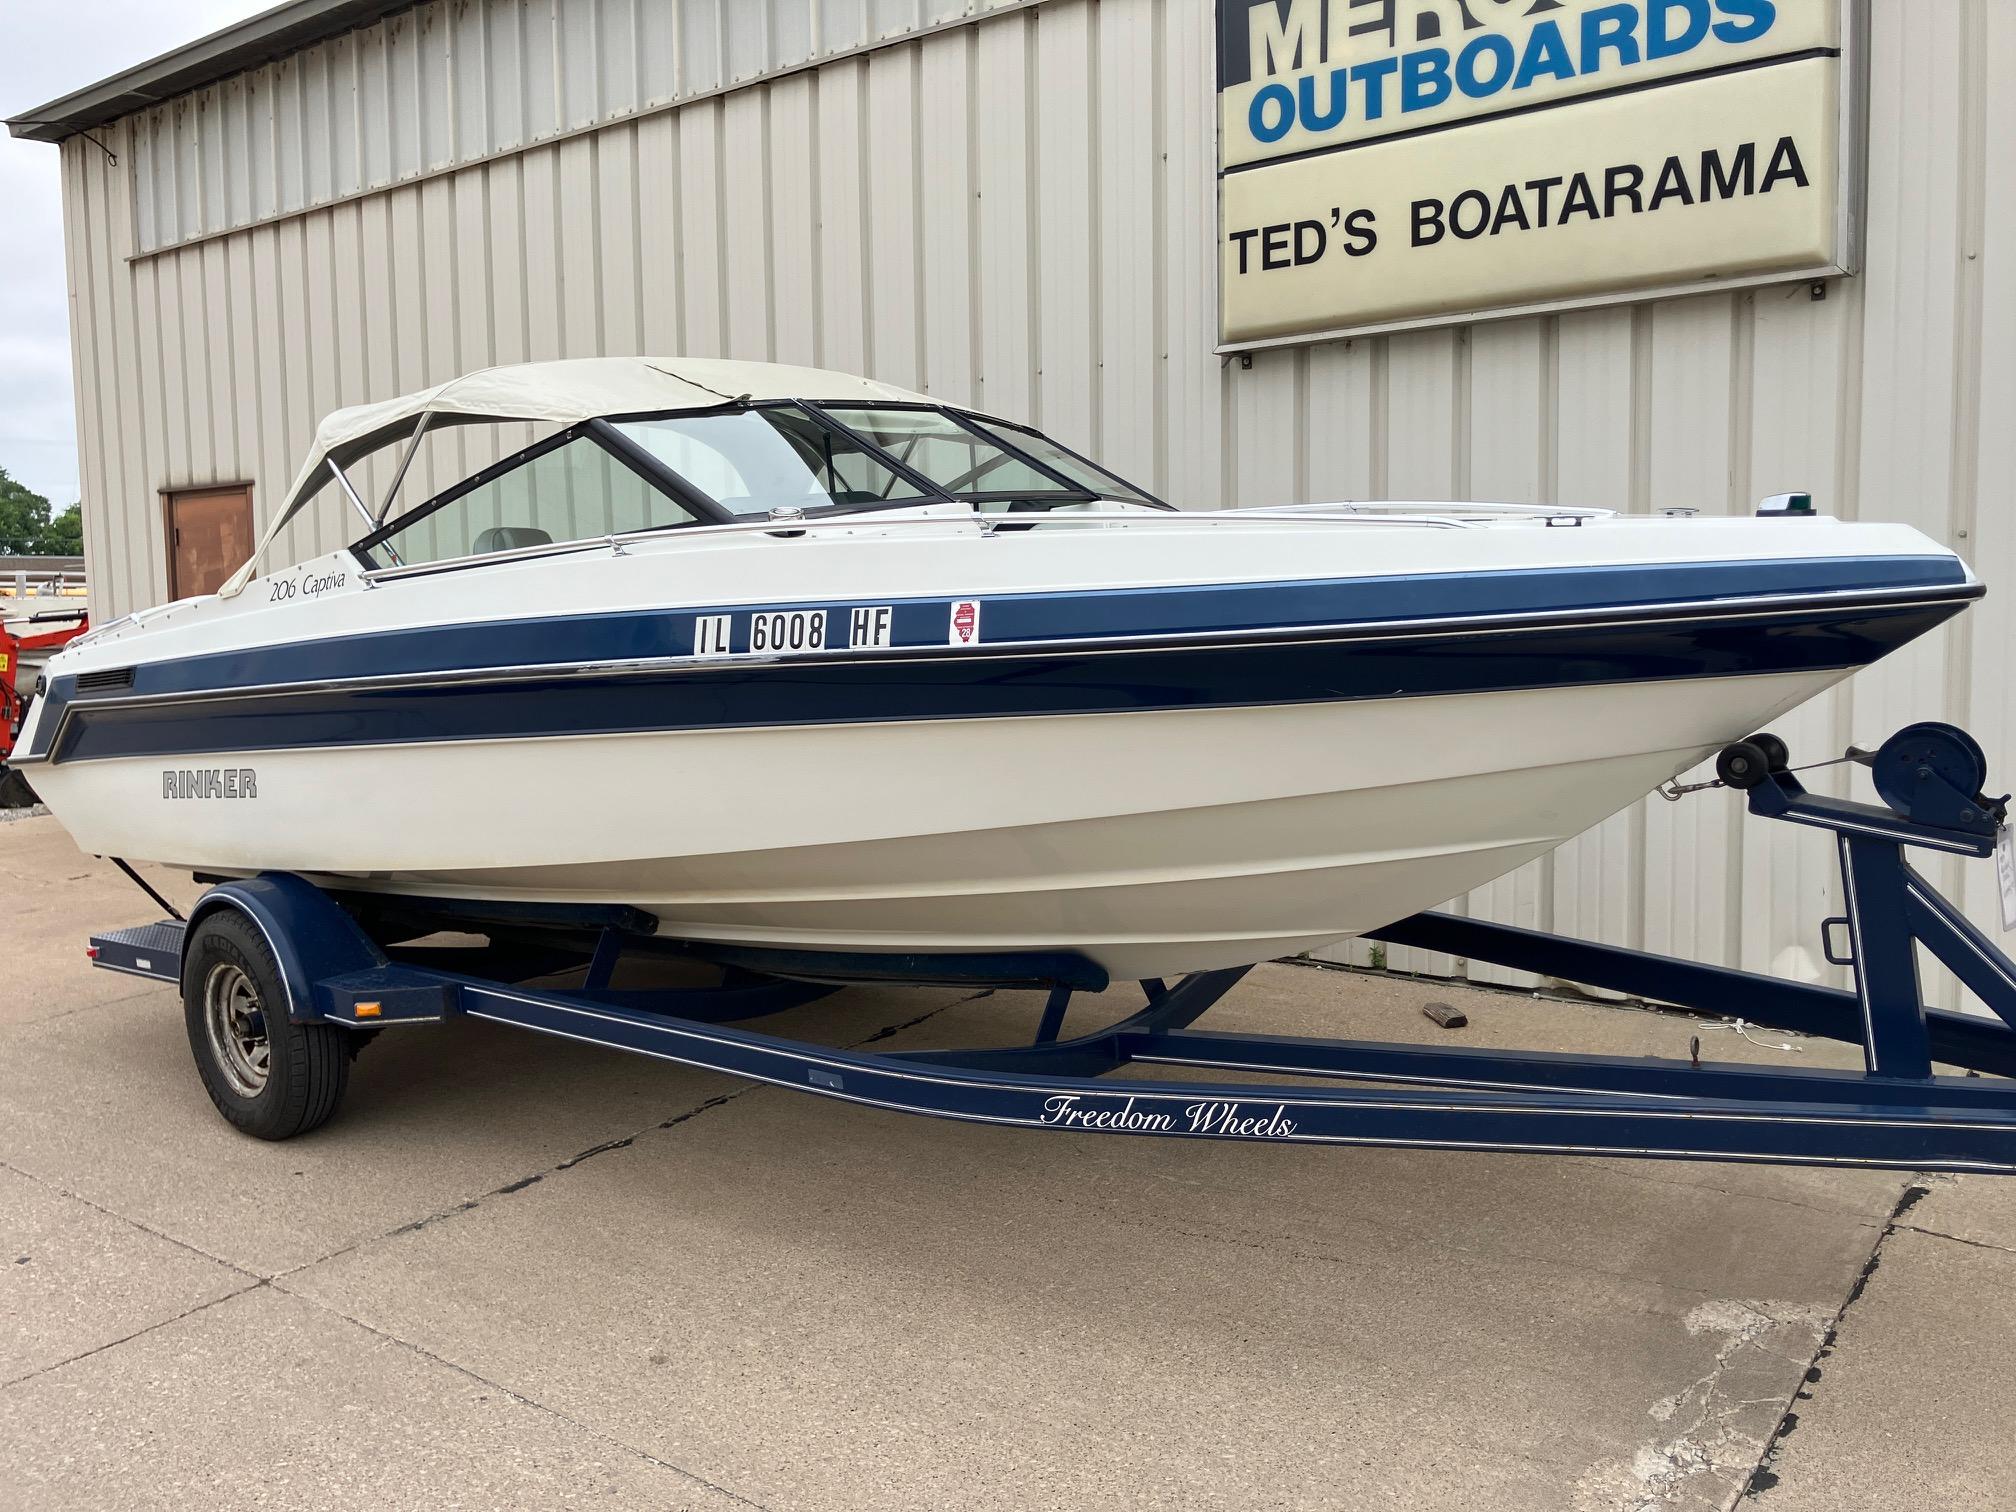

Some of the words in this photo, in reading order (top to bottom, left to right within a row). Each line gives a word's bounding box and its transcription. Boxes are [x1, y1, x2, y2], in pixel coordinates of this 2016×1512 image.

[1249, 0, 1776, 143] OUTBOARDS
[1229, 207, 1378, 275] TED'S
[1410, 135, 1810, 248] BOATARAMA
[270, 579, 297, 602] 206
[302, 572, 346, 598] Captiva
[700, 617, 727, 654] IL
[752, 612, 824, 651] 6008
[853, 607, 890, 646] HF
[162, 768, 258, 799] RINKER
[1040, 1095, 1177, 1131] Freedom
[1185, 1101, 1298, 1137] Wheels
